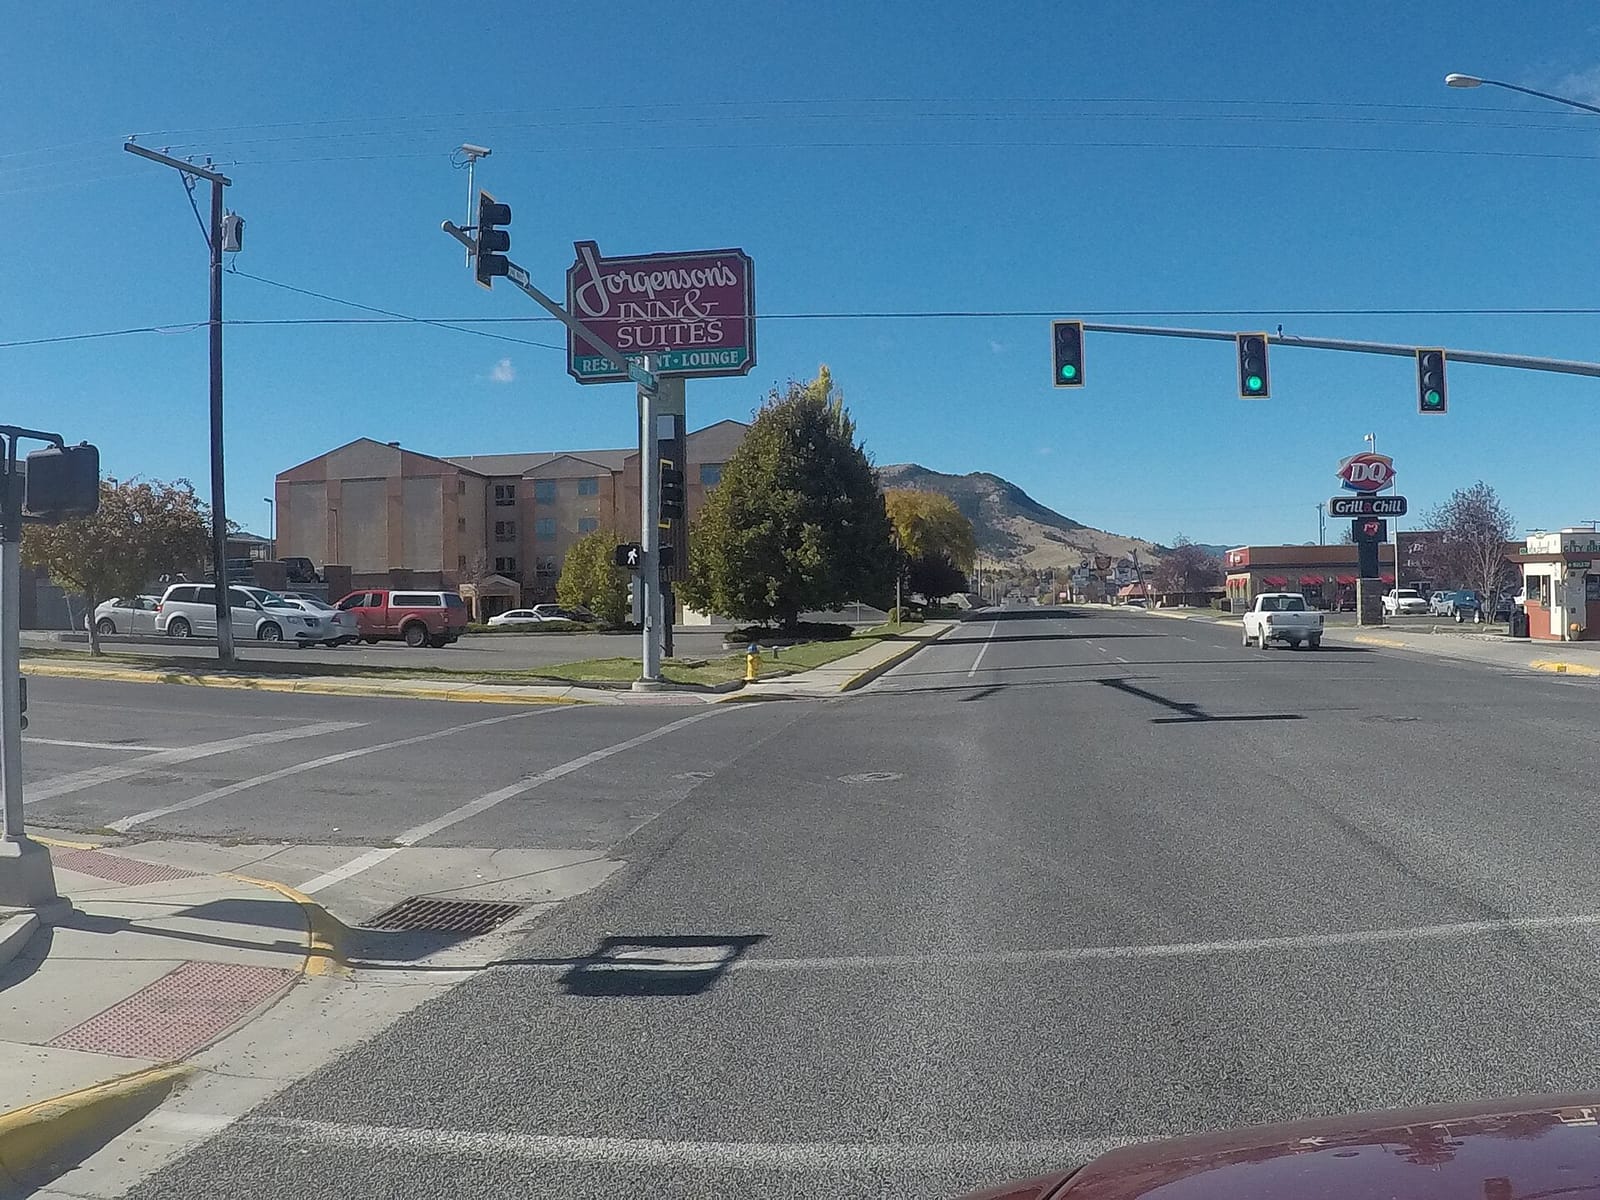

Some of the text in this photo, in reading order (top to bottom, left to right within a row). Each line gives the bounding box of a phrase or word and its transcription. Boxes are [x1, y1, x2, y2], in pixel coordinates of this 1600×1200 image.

[576, 247, 737, 317] Jorgenson's
[617, 321, 724, 348] SUITES
[682, 351, 738, 366] LOUNGE
[1350, 462, 1388, 484] DQ
[1336, 500, 1364, 513] Grill
[1372, 500, 1401, 513] Chill
